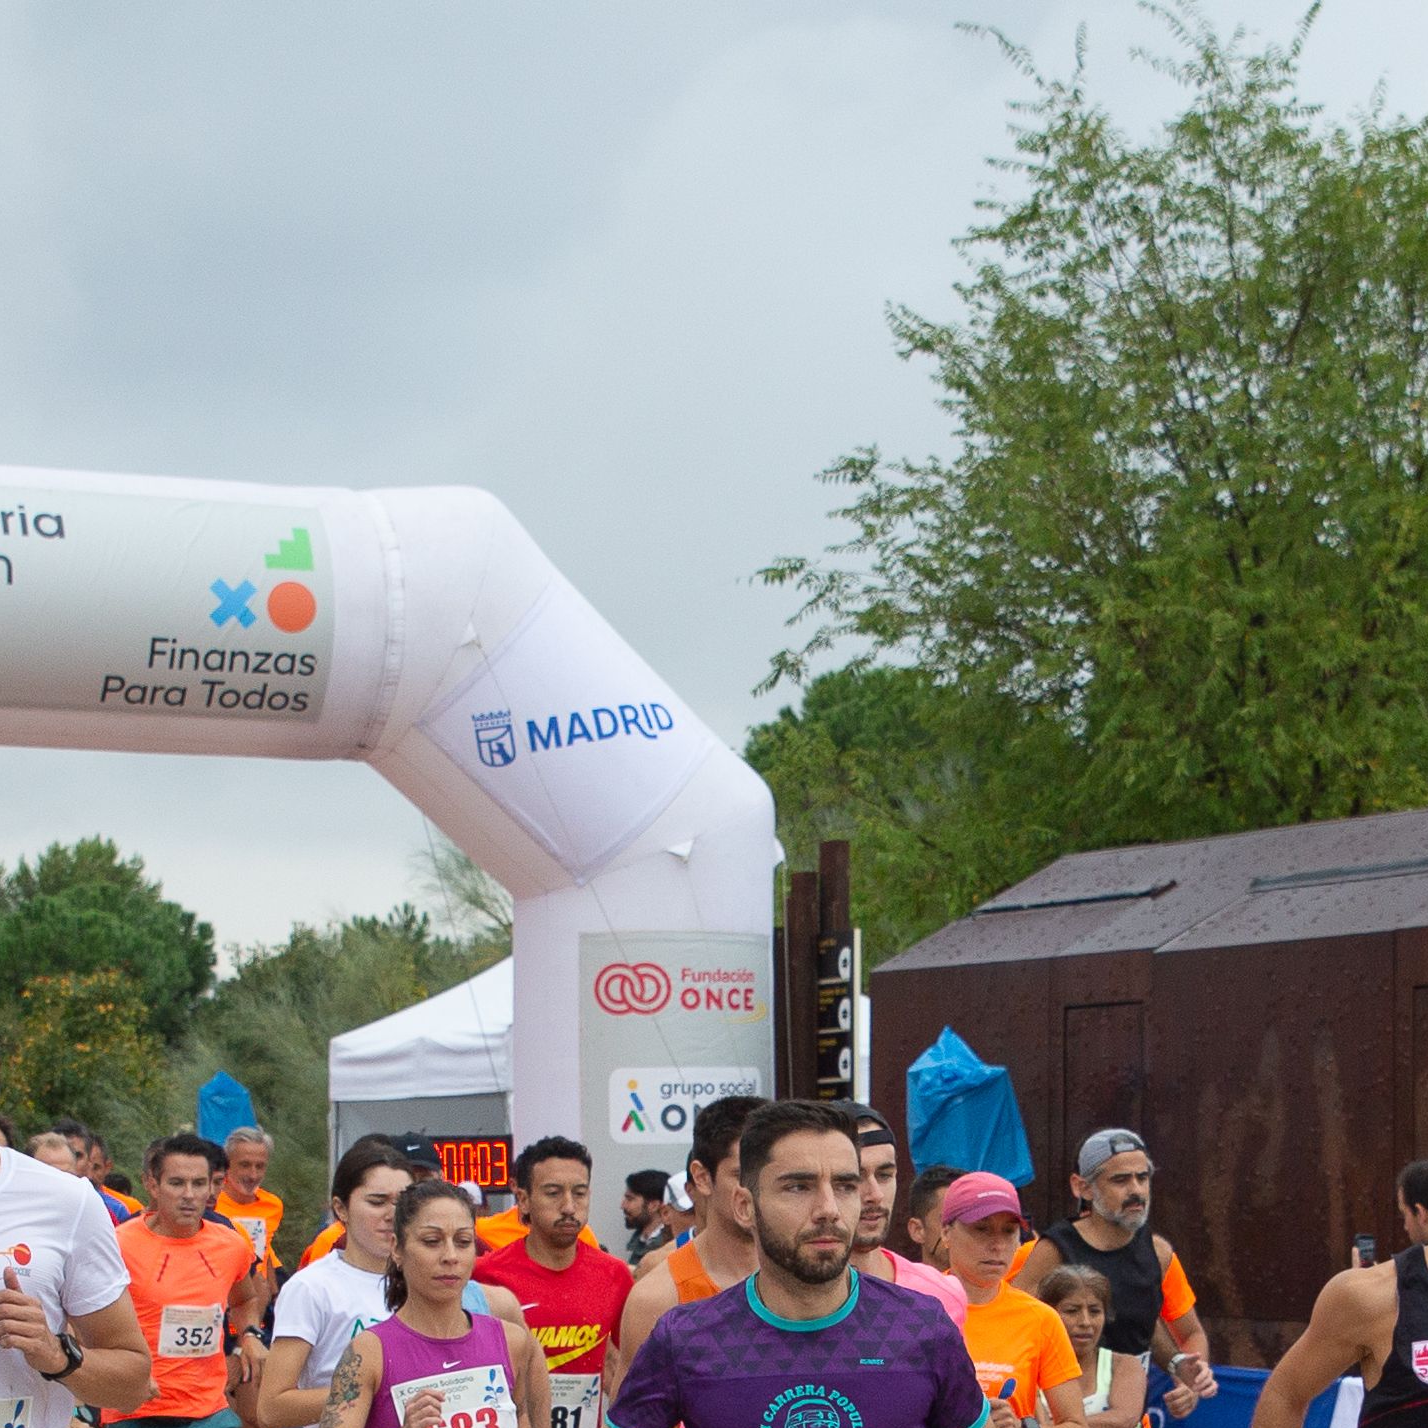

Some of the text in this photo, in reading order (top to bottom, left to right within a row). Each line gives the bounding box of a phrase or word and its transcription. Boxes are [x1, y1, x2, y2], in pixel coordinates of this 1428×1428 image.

[148, 637, 317, 676] Finanzas
[100, 675, 309, 712] Para Todos
[526, 703, 674, 752] MADRID
[681, 968, 754, 983] Fundación
[680, 988, 754, 1011] ONCE
[660, 1079, 756, 1101] grupo social
[175, 1327, 213, 1346] 352
[531, 1324, 601, 1348] VAMOS
[763, 1384, 825, 1422] CARRERA
